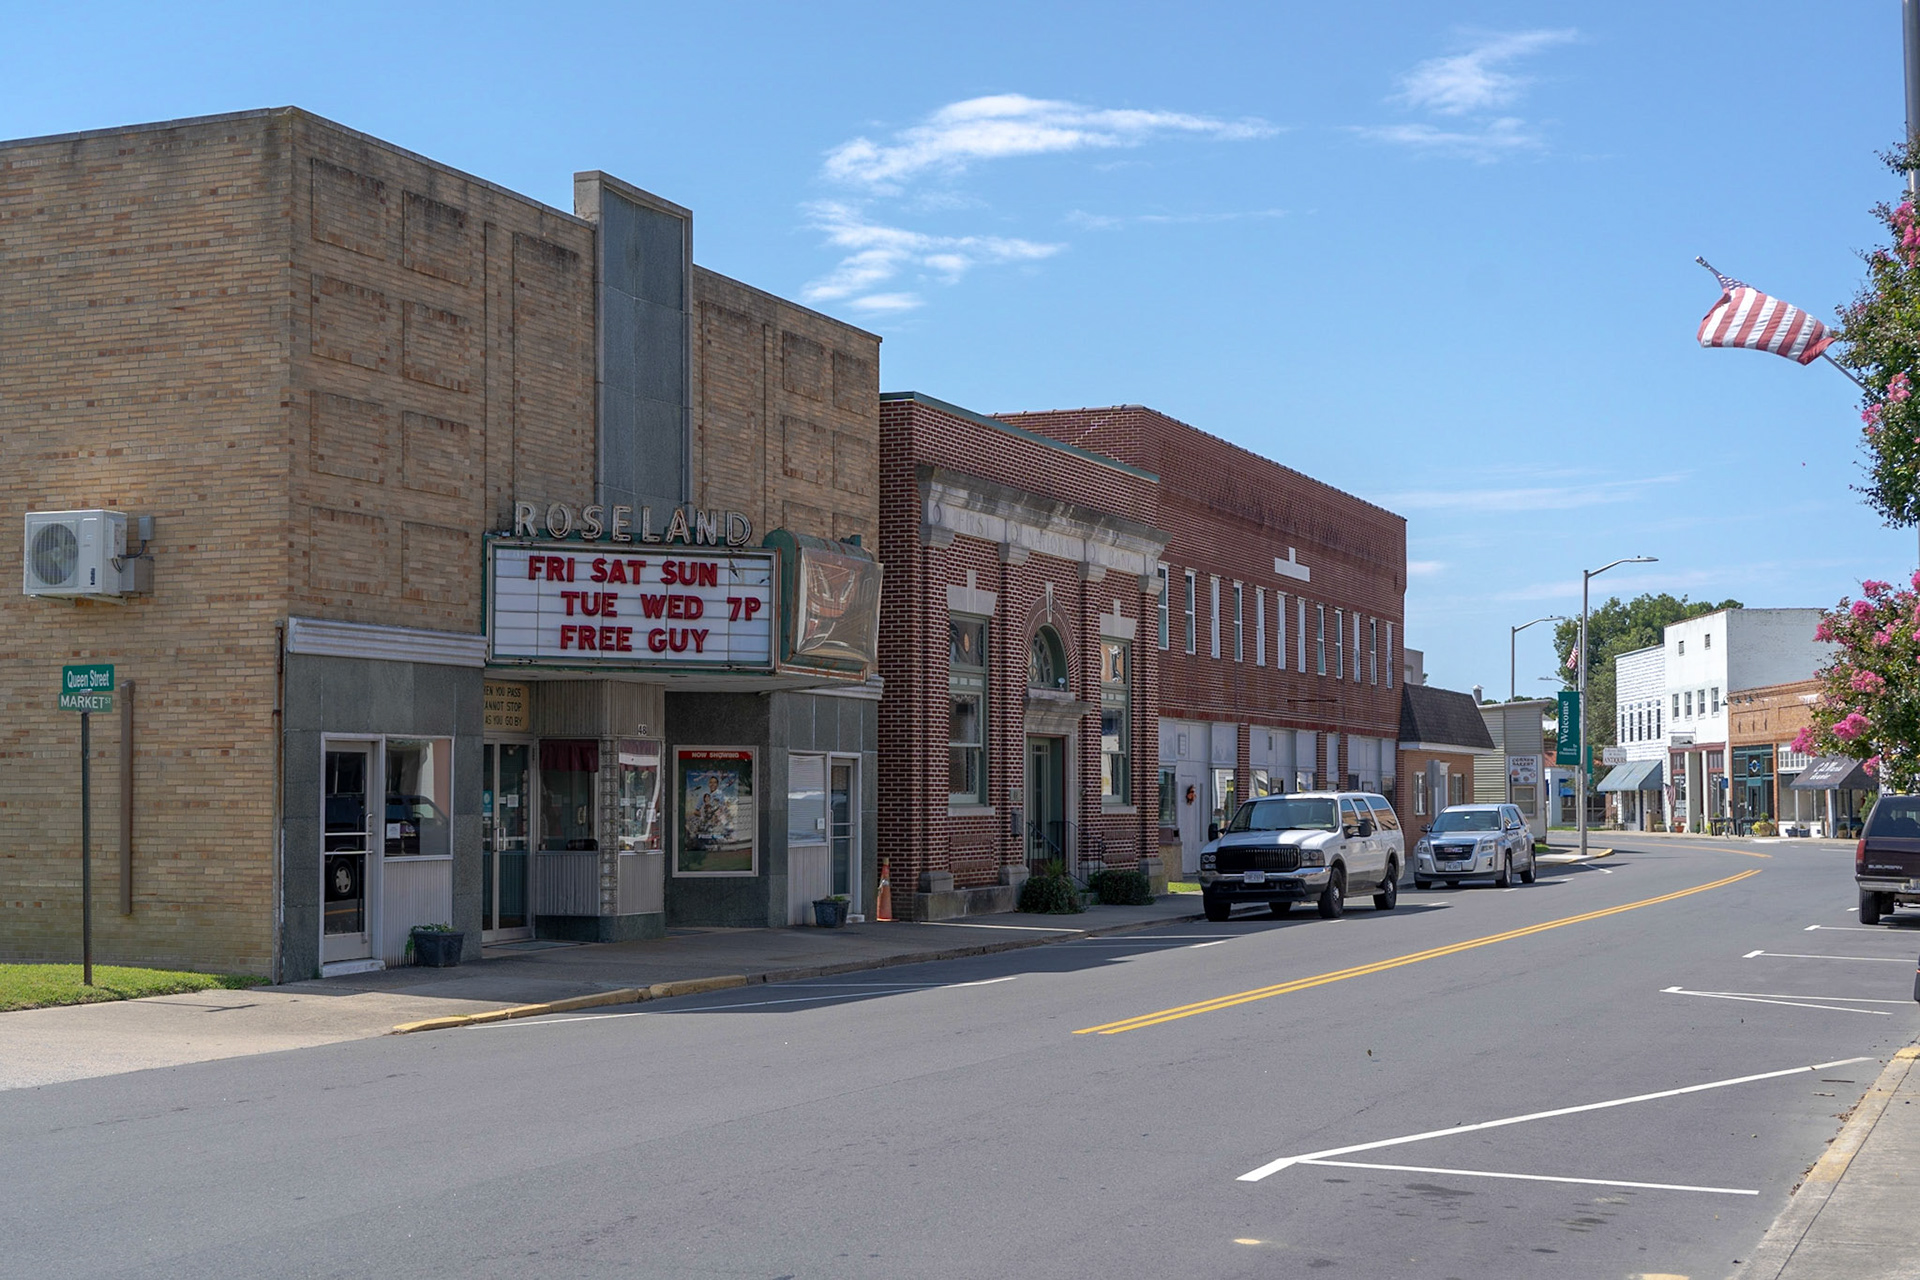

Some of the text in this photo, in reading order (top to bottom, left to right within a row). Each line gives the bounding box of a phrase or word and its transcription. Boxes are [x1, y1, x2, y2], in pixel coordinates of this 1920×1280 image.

[514, 501, 752, 547] ROSELAND
[957, 511, 990, 537] FIRST
[1028, 530, 1076, 557] NATIONAL
[528, 555, 718, 587] FRI SAT SUN
[560, 591, 762, 622] TUE WED 7P
[560, 624, 710, 653] FREE GUY
[67, 669, 109, 688] Queen Street
[60, 695, 105, 709] MARKET
[496, 686, 505, 697] YOU
[507, 687, 521, 698] PASS
[506, 701, 522, 712] STOP
[493, 715, 503, 725] YOU
[505, 716, 514, 726] GO
[514, 716, 523, 727] BY
[1560, 700, 1569, 744] Welcome
[691, 751, 740, 759] NOW SHOWING
